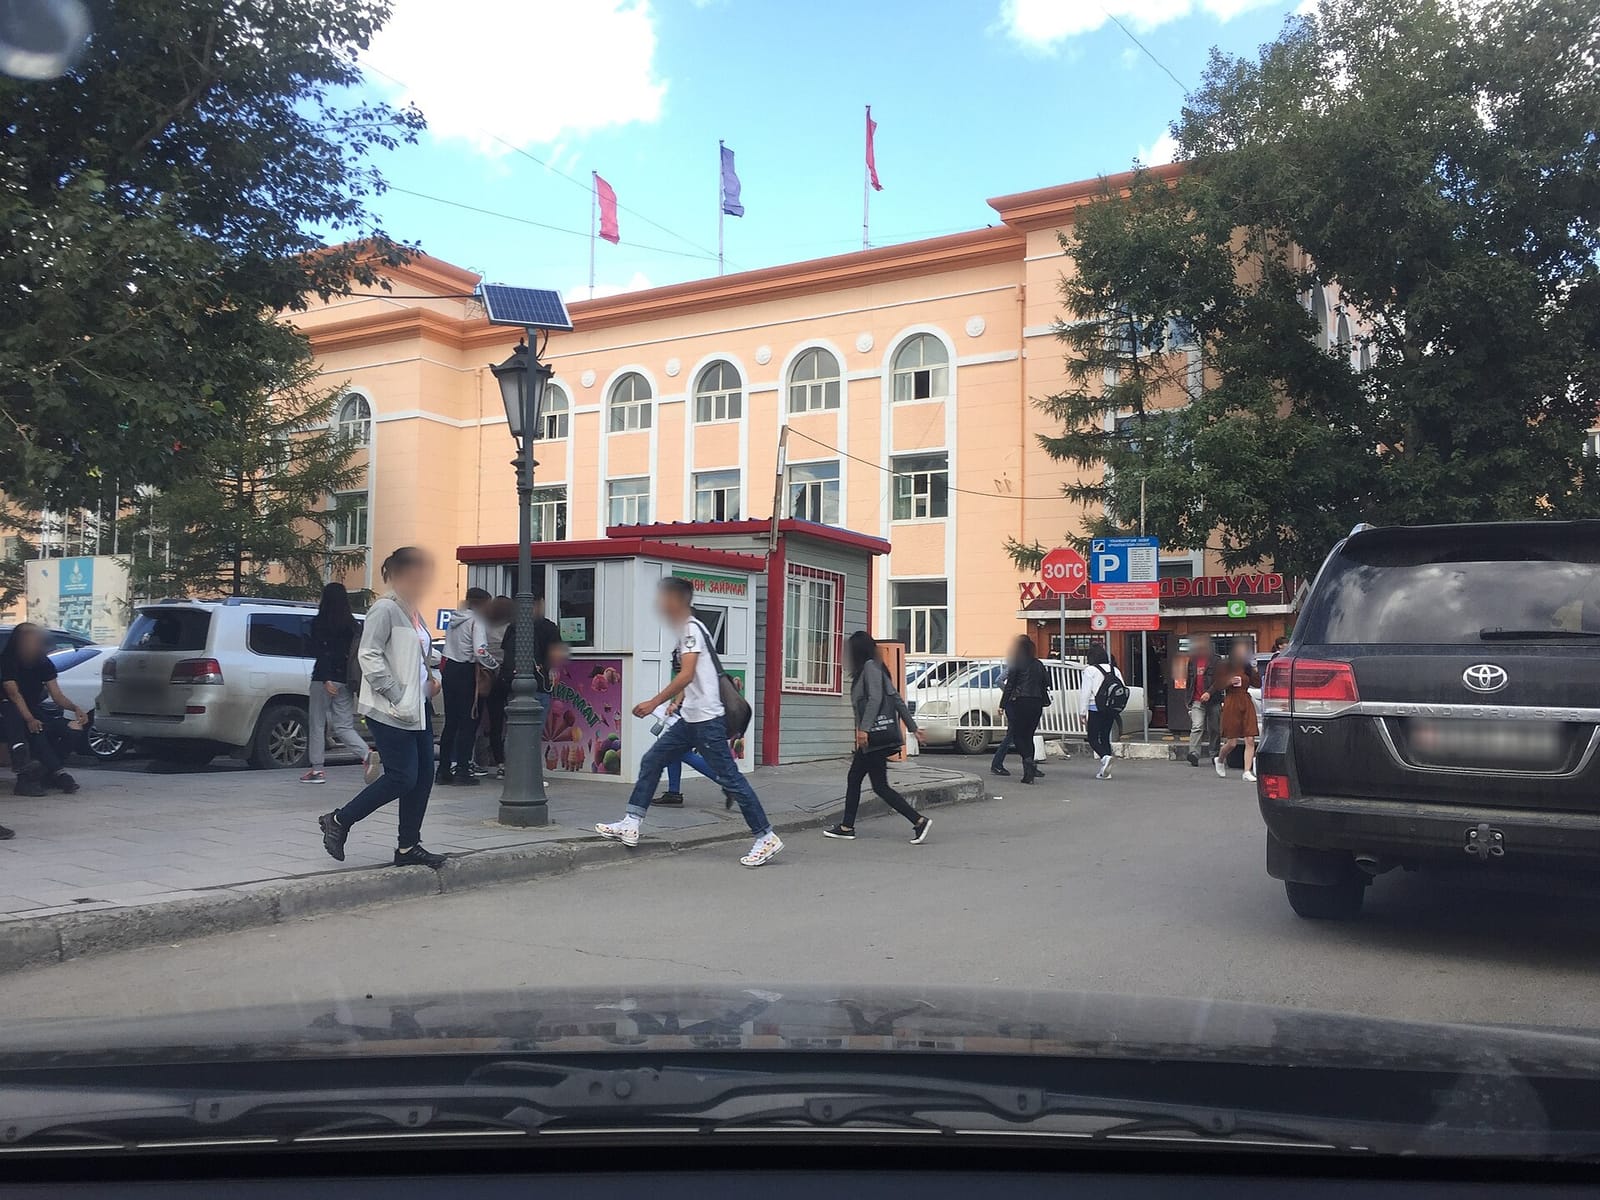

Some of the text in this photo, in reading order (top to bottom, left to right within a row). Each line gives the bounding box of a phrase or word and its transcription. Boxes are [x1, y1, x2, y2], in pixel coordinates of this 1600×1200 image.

[1044, 563, 1084, 579] ЗОГС
[1098, 554, 1120, 582] P
[1158, 574, 1282, 598] ДЭЛГҮҮР
[439, 611, 451, 630] P
[1300, 725, 1323, 735] VX
